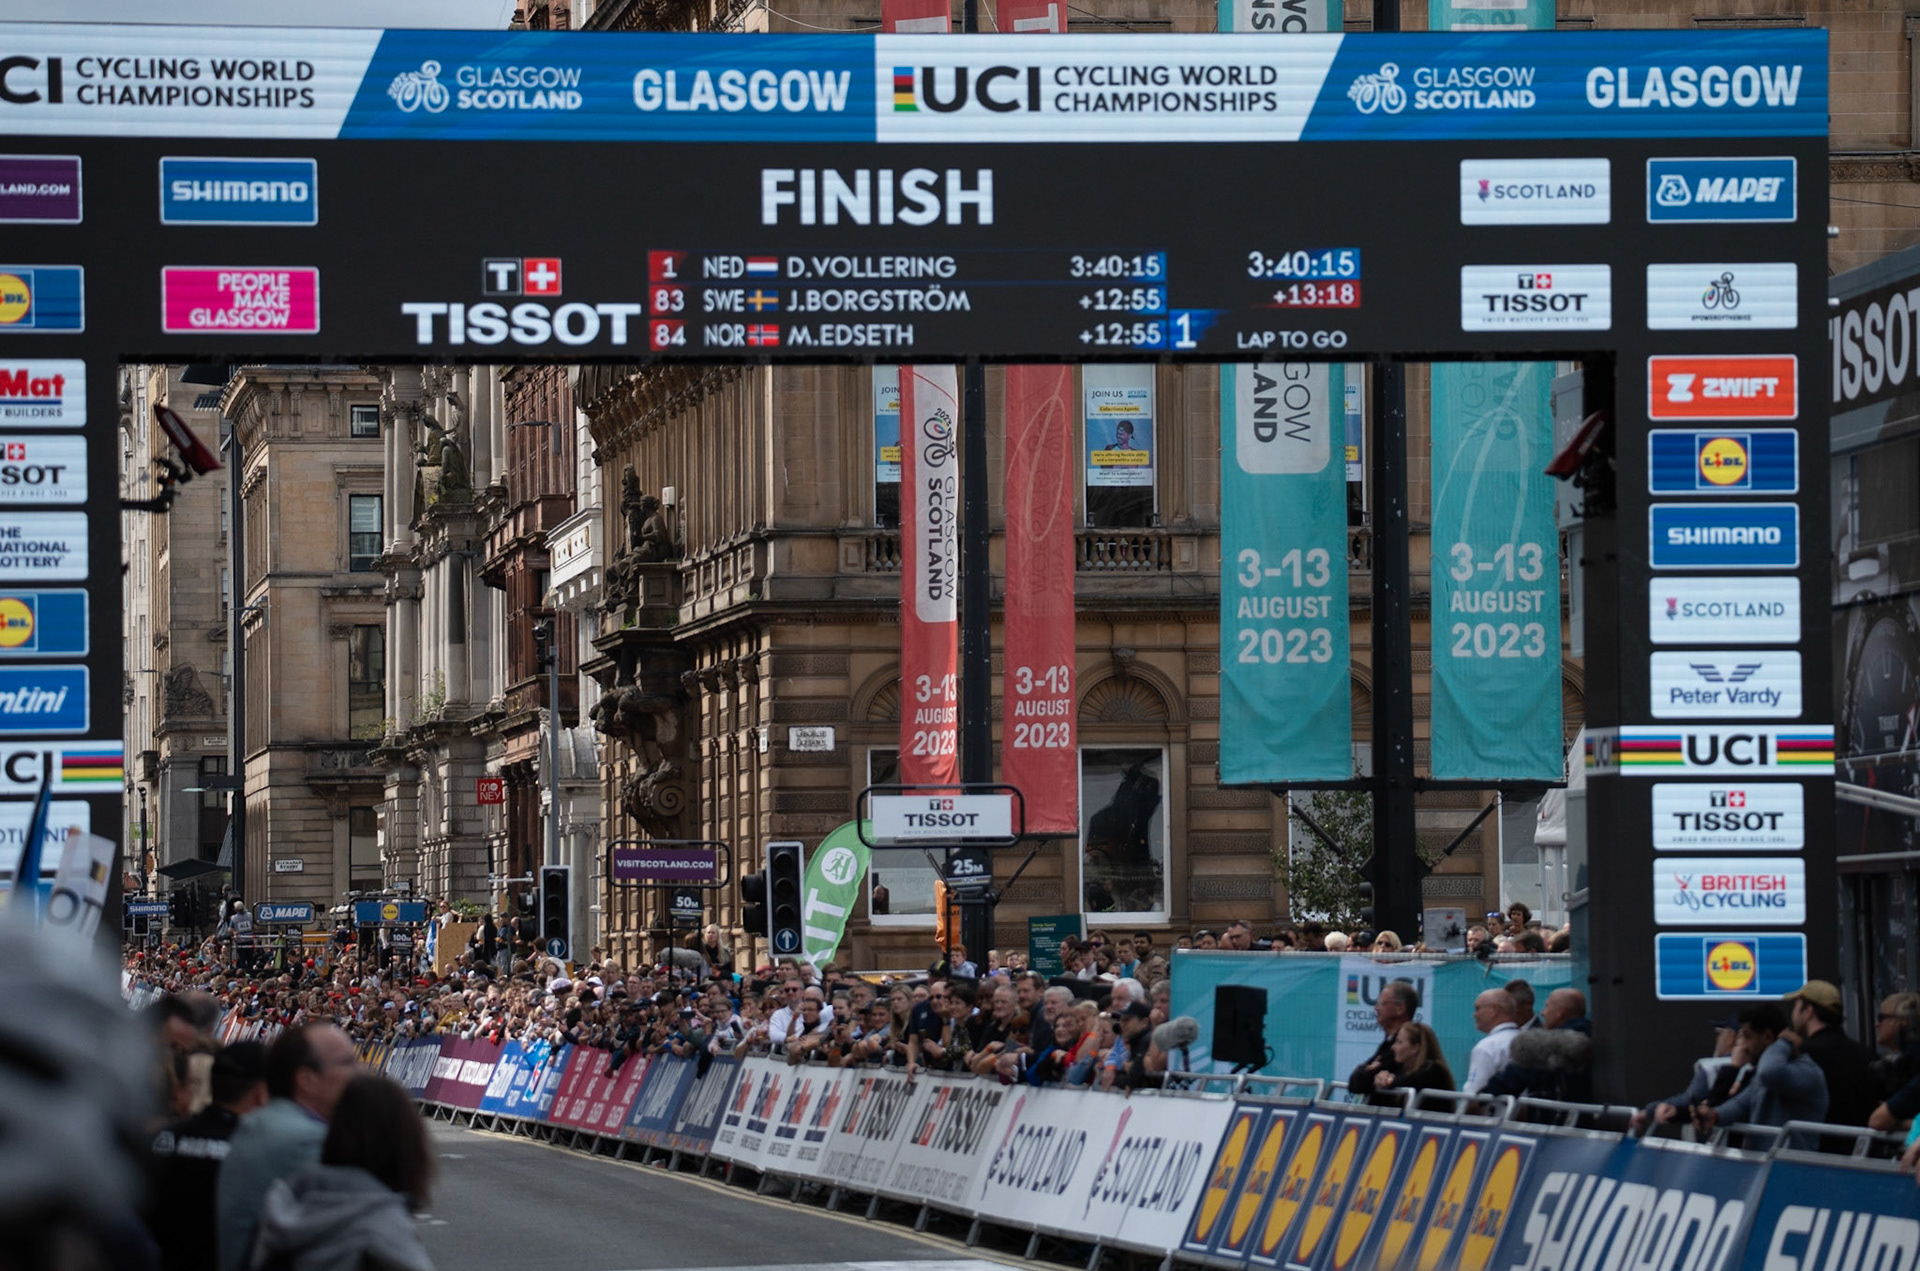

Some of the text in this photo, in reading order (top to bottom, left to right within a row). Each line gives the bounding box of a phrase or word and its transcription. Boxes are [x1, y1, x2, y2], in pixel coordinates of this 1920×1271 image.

[77, 58, 314, 82] CYCLING WORLD
[456, 66, 582, 88] GLASGOW
[1054, 66, 1276, 86] CYCLING WORLD
[1414, 66, 1535, 87] GLASGOW
[77, 85, 314, 108] CHAMPIONSHIPS
[633, 69, 851, 112] GLASGOW
[920, 66, 1040, 112] UCI
[1586, 65, 1802, 108] GLASGOW
[457, 89, 582, 110] SCOTLAND
[1054, 93, 1276, 112] CHAMPIONSHIPS
[1414, 91, 1535, 109] SCOTLAND
[172, 180, 309, 202] SHIMANO
[761, 168, 994, 225] FINISH
[1494, 184, 1596, 199] SCOTLAND
[1696, 177, 1781, 203] MAPEI
[662, 255, 1161, 278] 1 NED D.VOLLERING 3:40:15
[1247, 250, 1355, 277] 3:40:15
[218, 273, 290, 291] PEOPLE
[234, 292, 290, 309] MAKE
[655, 284, 1161, 312] 83 SWE J.BORGSTRÖM +12:55
[1273, 283, 1355, 305] +13:18
[1482, 294, 1588, 313] TISSOT
[189, 308, 290, 327] GLASGOW
[402, 303, 642, 345] TISSOT
[655, 322, 1161, 347] 84 NOR M.EDSETH +12:55
[1175, 312, 1348, 349] 1 LAP TO GO
[1091, 390, 1111, 399] JOIN
[1112, 390, 1123, 398] US
[1702, 376, 1779, 398] ZWIFT
[5, 408, 63, 418] BUILDERS
[1253, 363, 1278, 443] AND
[928, 477, 943, 601] SCOTLAND
[945, 476, 956, 599] GLASGOW
[1667, 527, 1782, 545] SHIMANO
[1238, 548, 1331, 588] 3-13
[1450, 542, 1543, 582] 3-13
[1237, 596, 1332, 619] AUGUST
[1451, 590, 1545, 613] AUGUST
[1682, 602, 1785, 617] SCOTLAND
[1238, 628, 1333, 664] 2023
[1451, 622, 1545, 658] 2023
[916, 673, 957, 702] 3-13
[1016, 665, 1070, 695] 3-13
[1014, 700, 1070, 717] AUGUST
[1670, 688, 1782, 707] Peter Vardy
[915, 707, 957, 724] AUGUST
[913, 730, 956, 756] 2023
[1013, 722, 1070, 749] 2023
[1686, 734, 1768, 766] UCI
[904, 813, 979, 827] TISSOT
[1672, 812, 1784, 831] TISSOT
[617, 858, 714, 869] VISITSCOTLAND.COM
[1702, 875, 1786, 890] BRITISH
[1702, 892, 1786, 908] CYCLING
[275, 907, 309, 918] MAPEI
[932, 1085, 1003, 1155] TISSOT
[999, 1123, 1088, 1196] SCOTLAND
[1103, 1135, 1203, 1213] SCOTLAND
